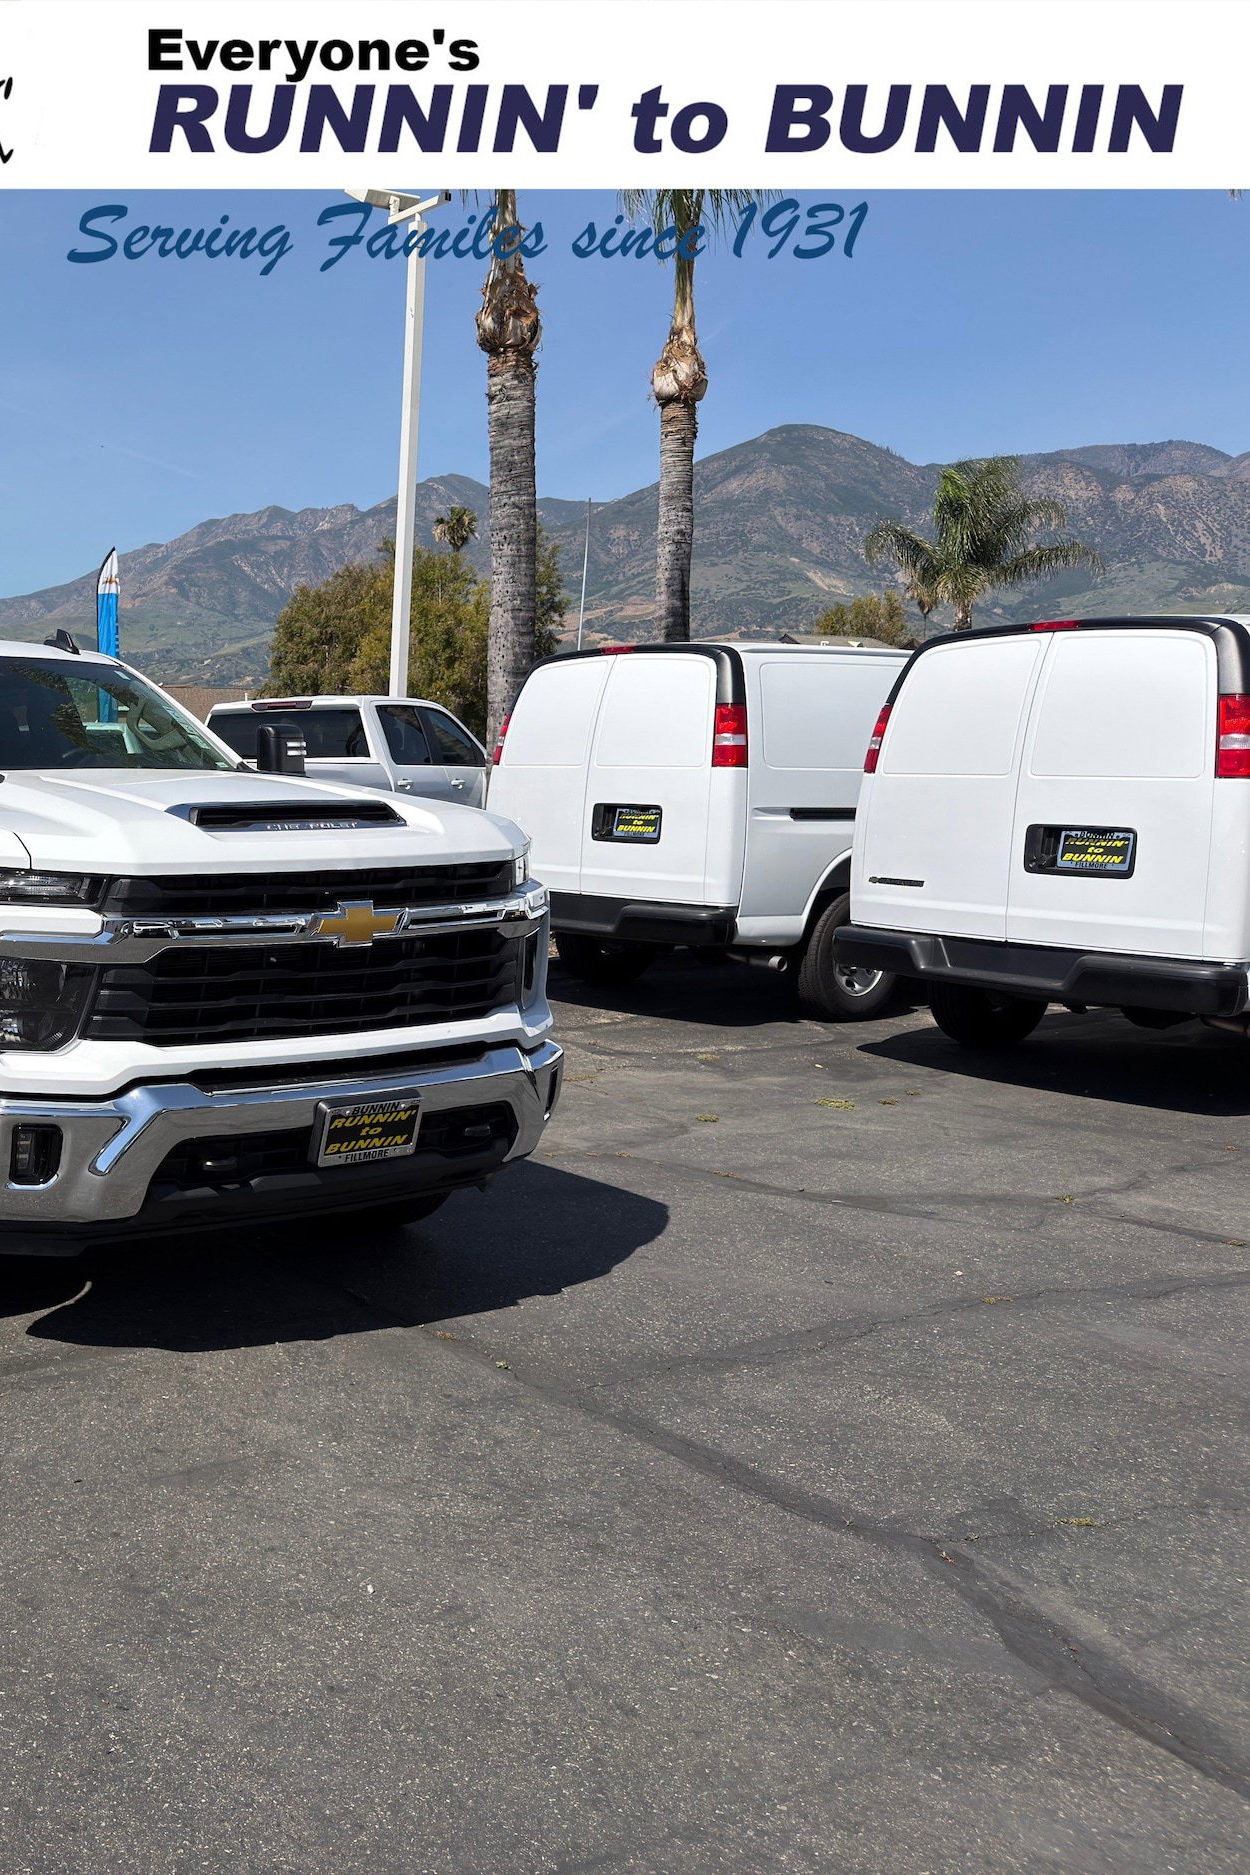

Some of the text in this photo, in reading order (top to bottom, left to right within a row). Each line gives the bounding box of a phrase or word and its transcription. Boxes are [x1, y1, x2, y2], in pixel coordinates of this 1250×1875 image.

[616, 824, 656, 833] BUNNIN
[1086, 846, 1105, 854] to
[1061, 852, 1124, 864] BUNNIN
[1075, 861, 1109, 870] FILLMORE
[351, 1102, 400, 1116] BUNNIN
[329, 1109, 417, 1130] RUNNIN'
[360, 1126, 383, 1137] to
[324, 1134, 409, 1155] BUNNIN
[344, 1148, 390, 1163] FILLMORE
